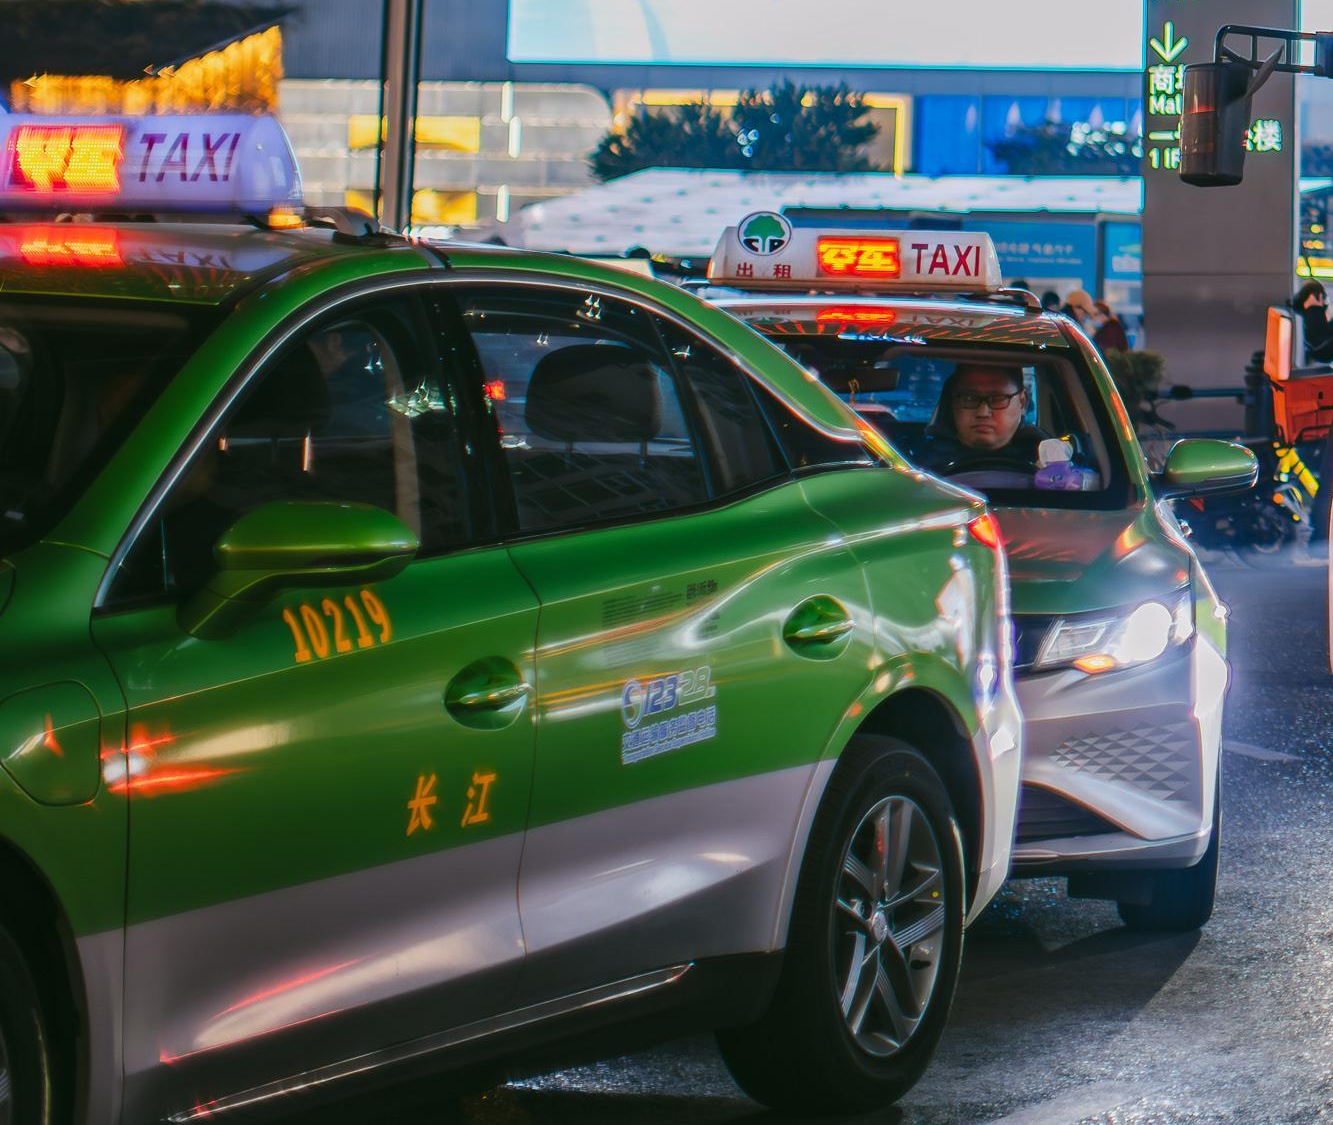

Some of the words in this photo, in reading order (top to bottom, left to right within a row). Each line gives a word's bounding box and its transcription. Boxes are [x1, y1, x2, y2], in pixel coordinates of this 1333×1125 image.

[138, 132, 241, 183] TAXI
[1148, 147, 1160, 169] 1
[1163, 147, 1182, 169] IF
[736, 262, 792, 280] 出租
[911, 243, 981, 277] TAXI
[283, 589, 393, 664] 10219
[406, 772, 497, 837] 长江
